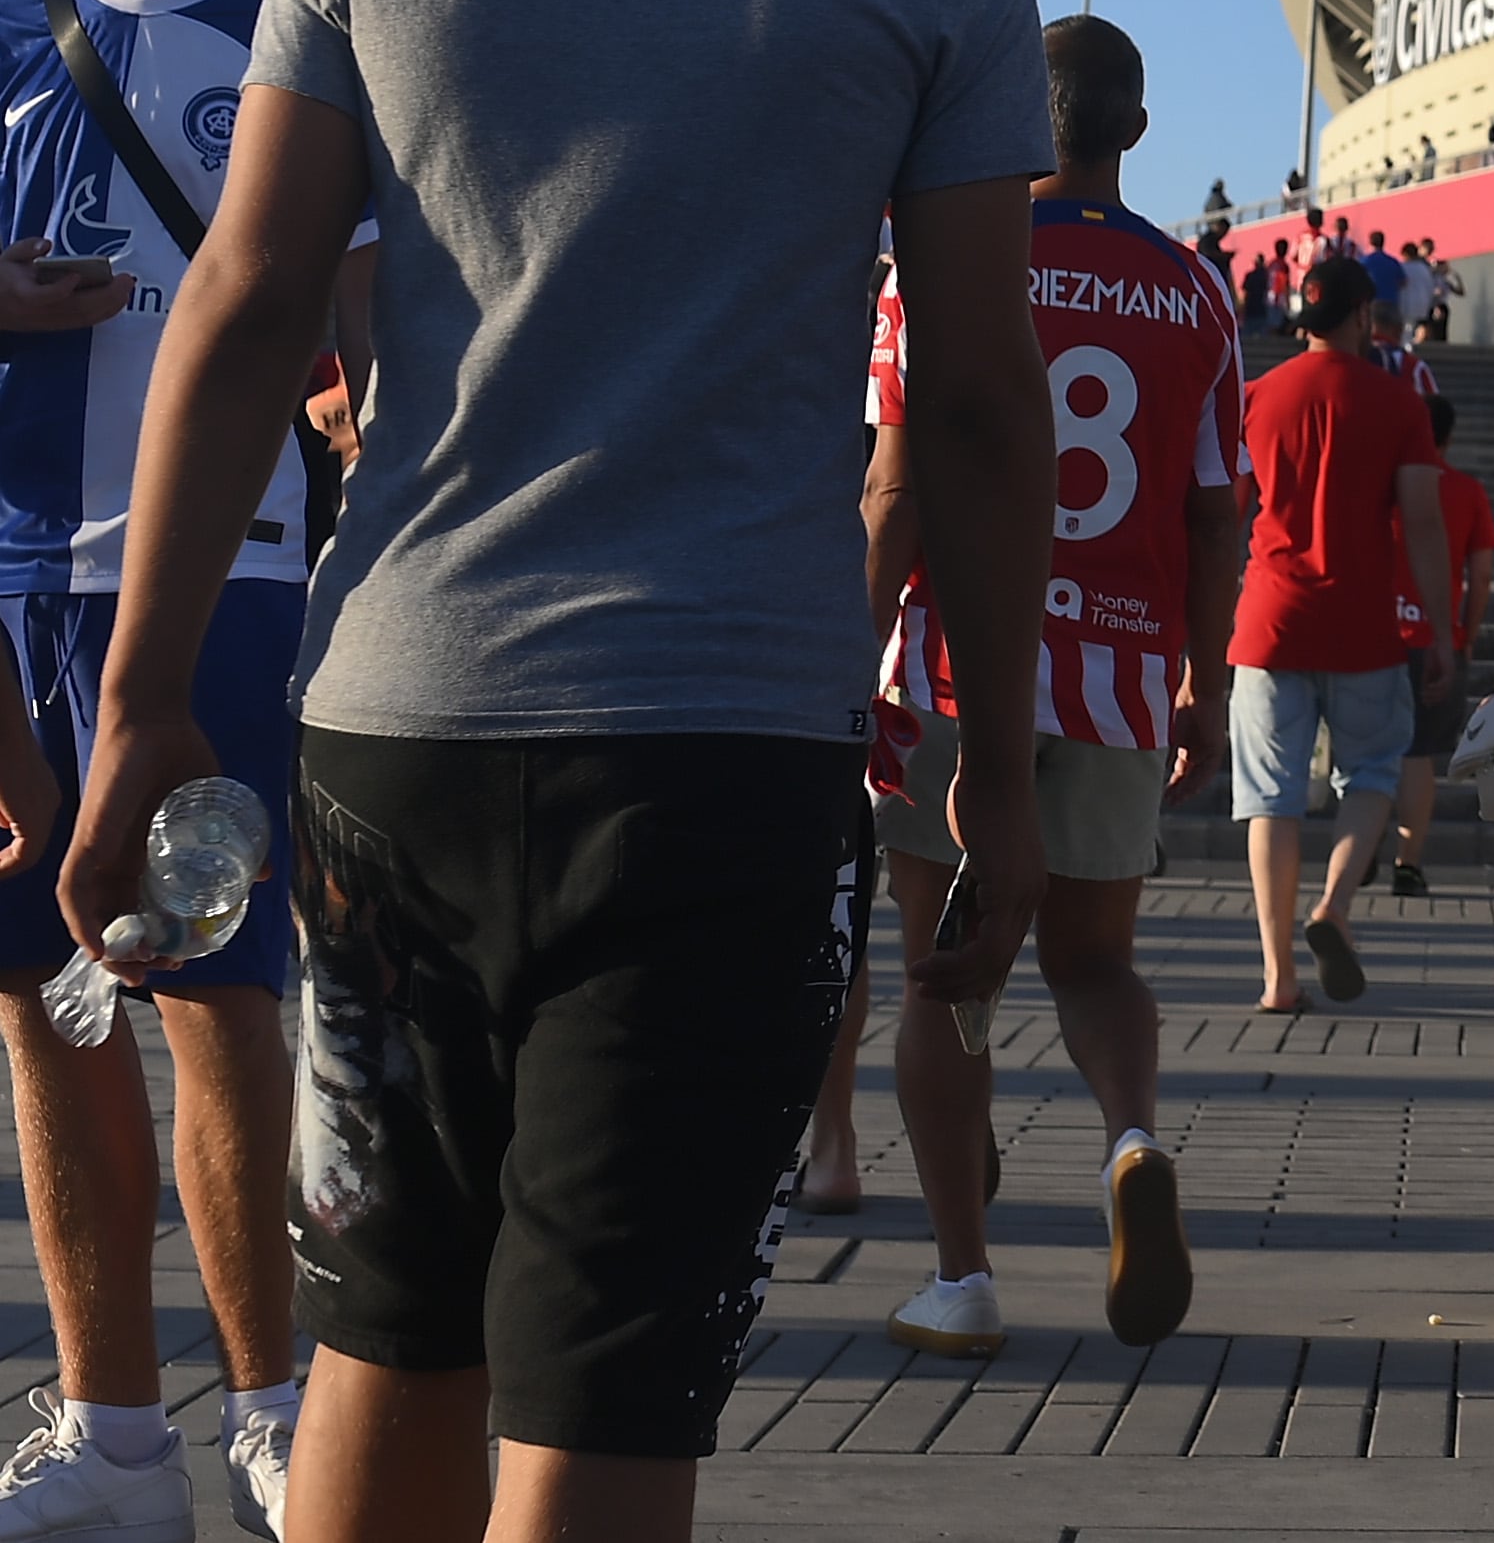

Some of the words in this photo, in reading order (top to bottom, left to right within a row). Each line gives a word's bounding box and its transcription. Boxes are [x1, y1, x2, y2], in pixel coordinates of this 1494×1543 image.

[1028, 267, 1198, 329] RIEZMANN
[1046, 344, 1138, 540] 8
[1091, 606, 1161, 635] Transfer
[1396, 595, 1420, 622] ia
